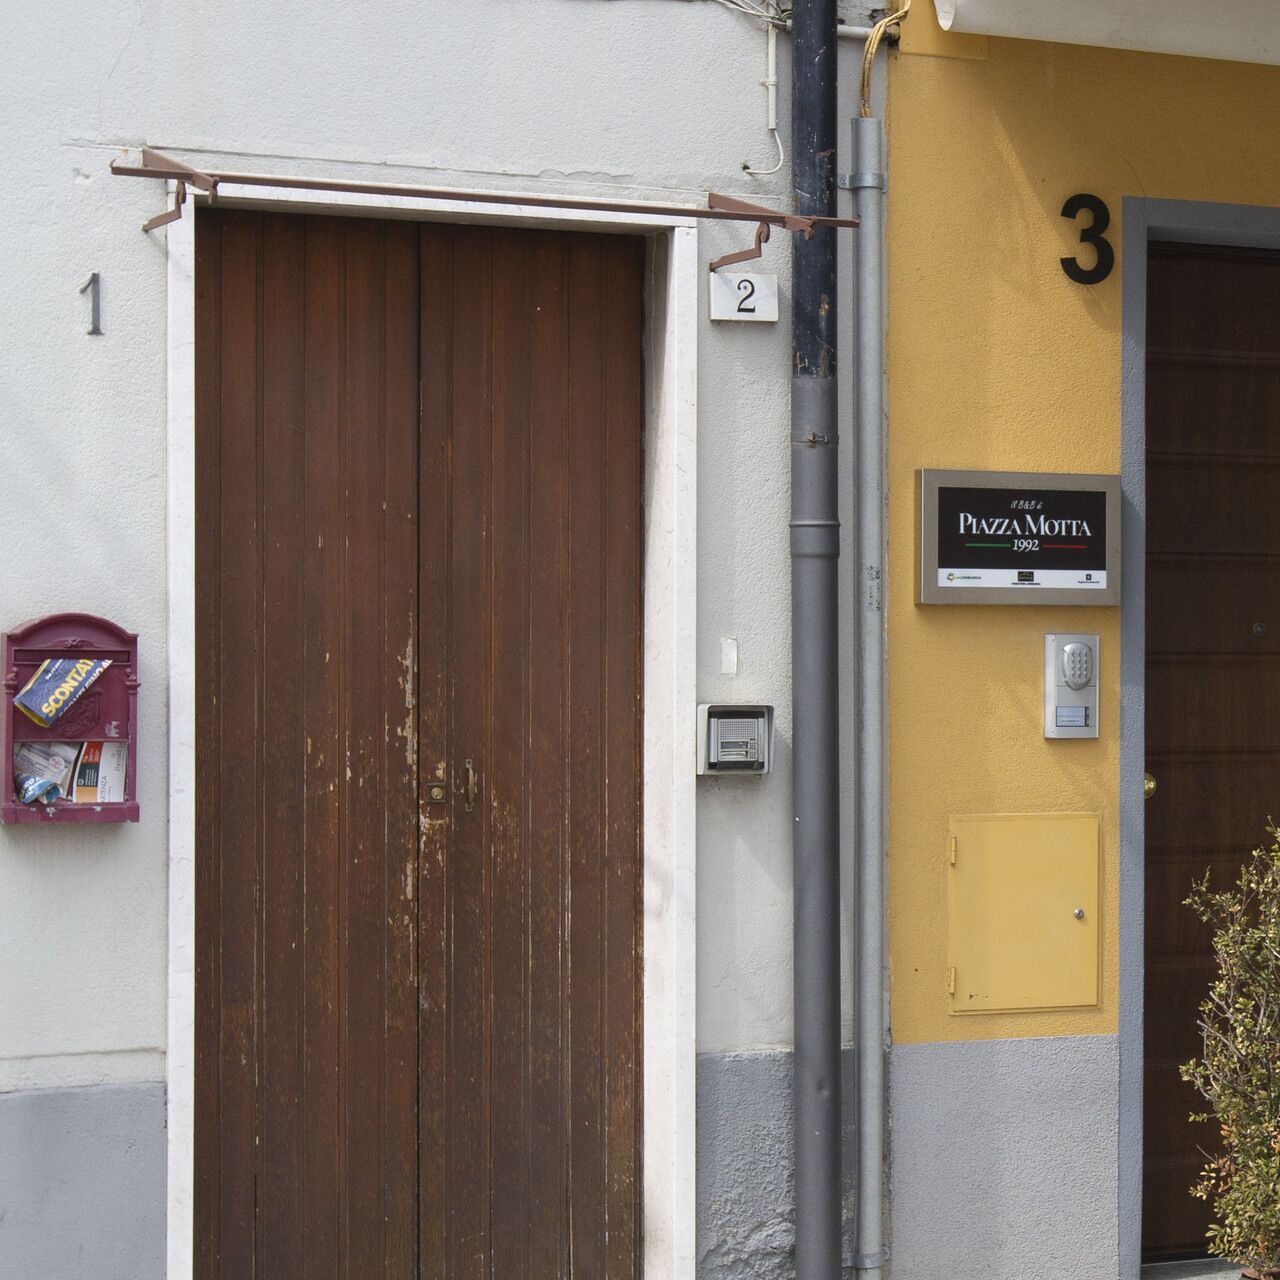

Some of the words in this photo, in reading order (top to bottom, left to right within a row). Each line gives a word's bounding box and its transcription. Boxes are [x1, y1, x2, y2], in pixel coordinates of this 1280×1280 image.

[1060, 193, 1115, 286] 3
[79, 272, 105, 336] 1
[736, 278, 756, 313] 2
[959, 512, 1022, 535] PIAZZA
[1025, 514, 1092, 537] MOTTA
[1012, 539, 1040, 552] 1992
